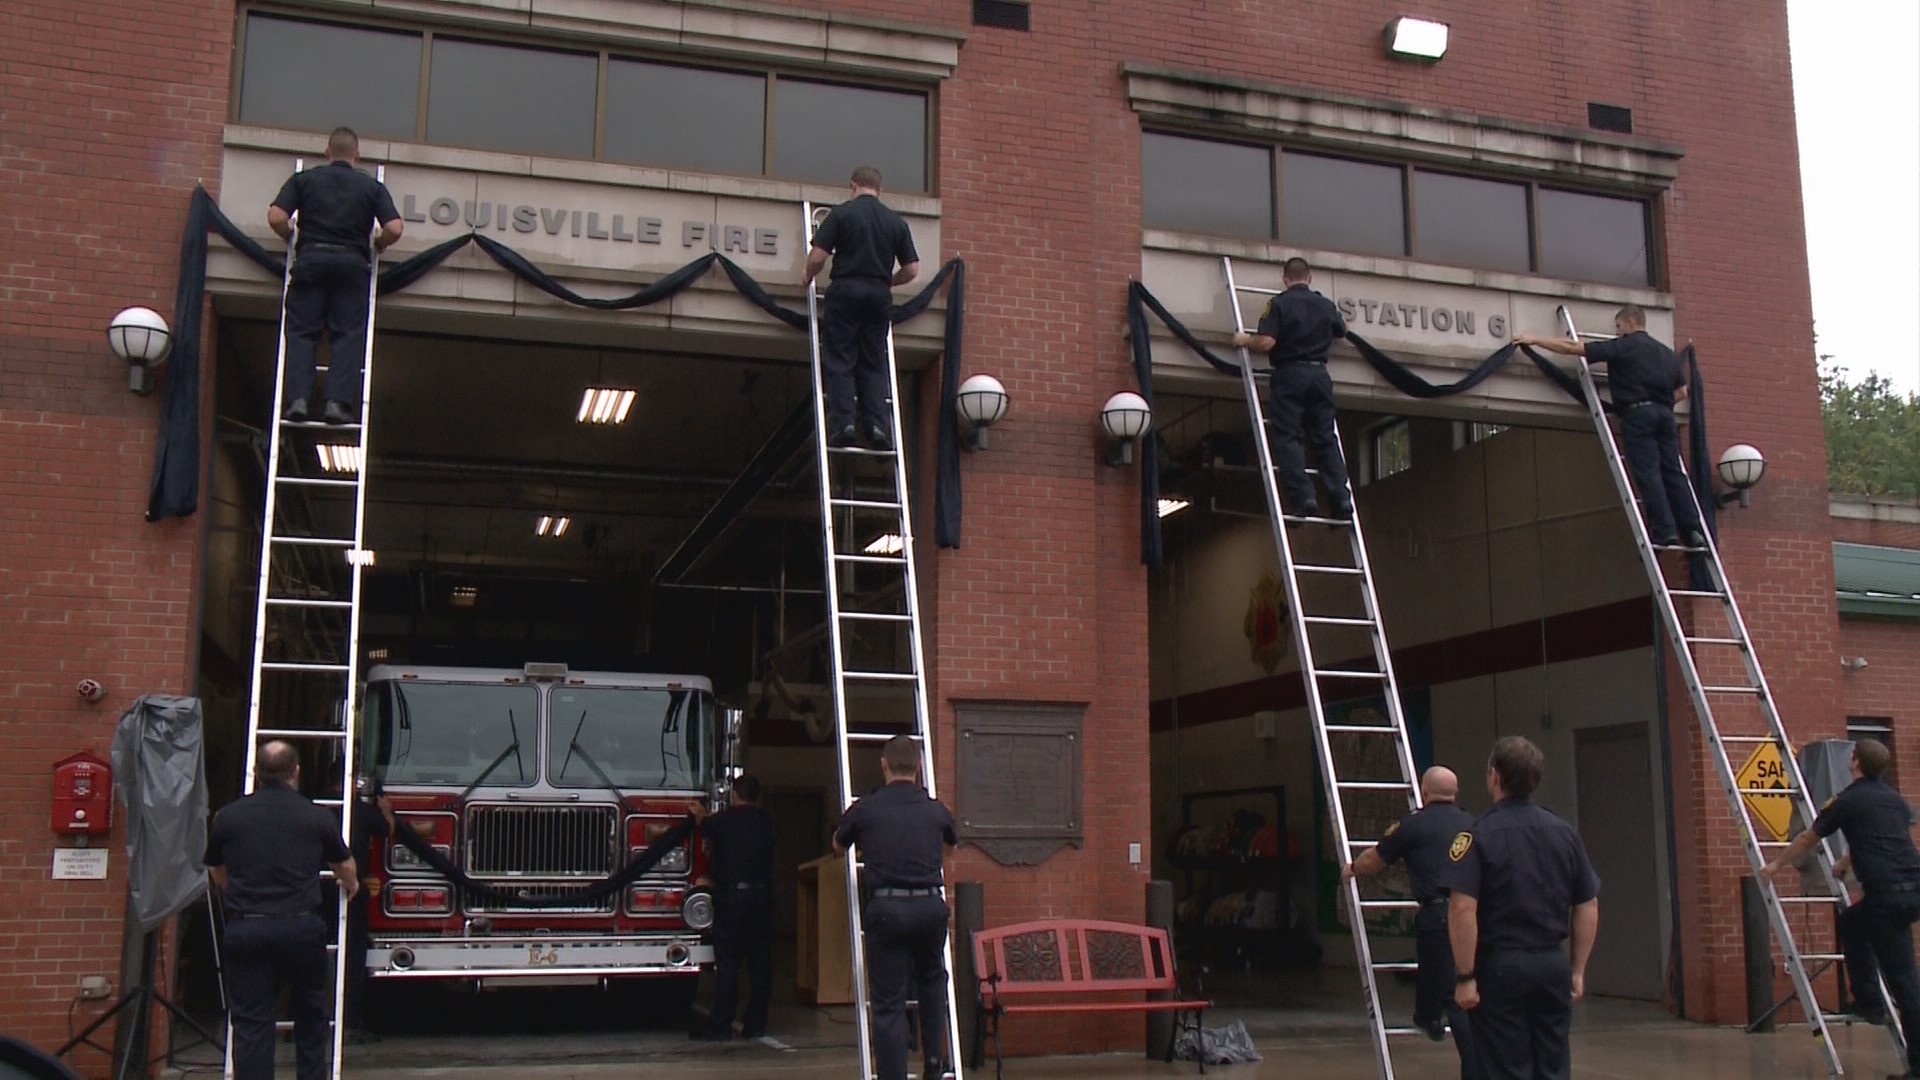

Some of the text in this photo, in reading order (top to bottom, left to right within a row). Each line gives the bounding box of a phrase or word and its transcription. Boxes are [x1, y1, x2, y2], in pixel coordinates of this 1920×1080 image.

[403, 194, 779, 255] LOUISVILLE FIRE
[1337, 296, 1507, 338] STATION 6
[528, 948, 558, 964] E-6
